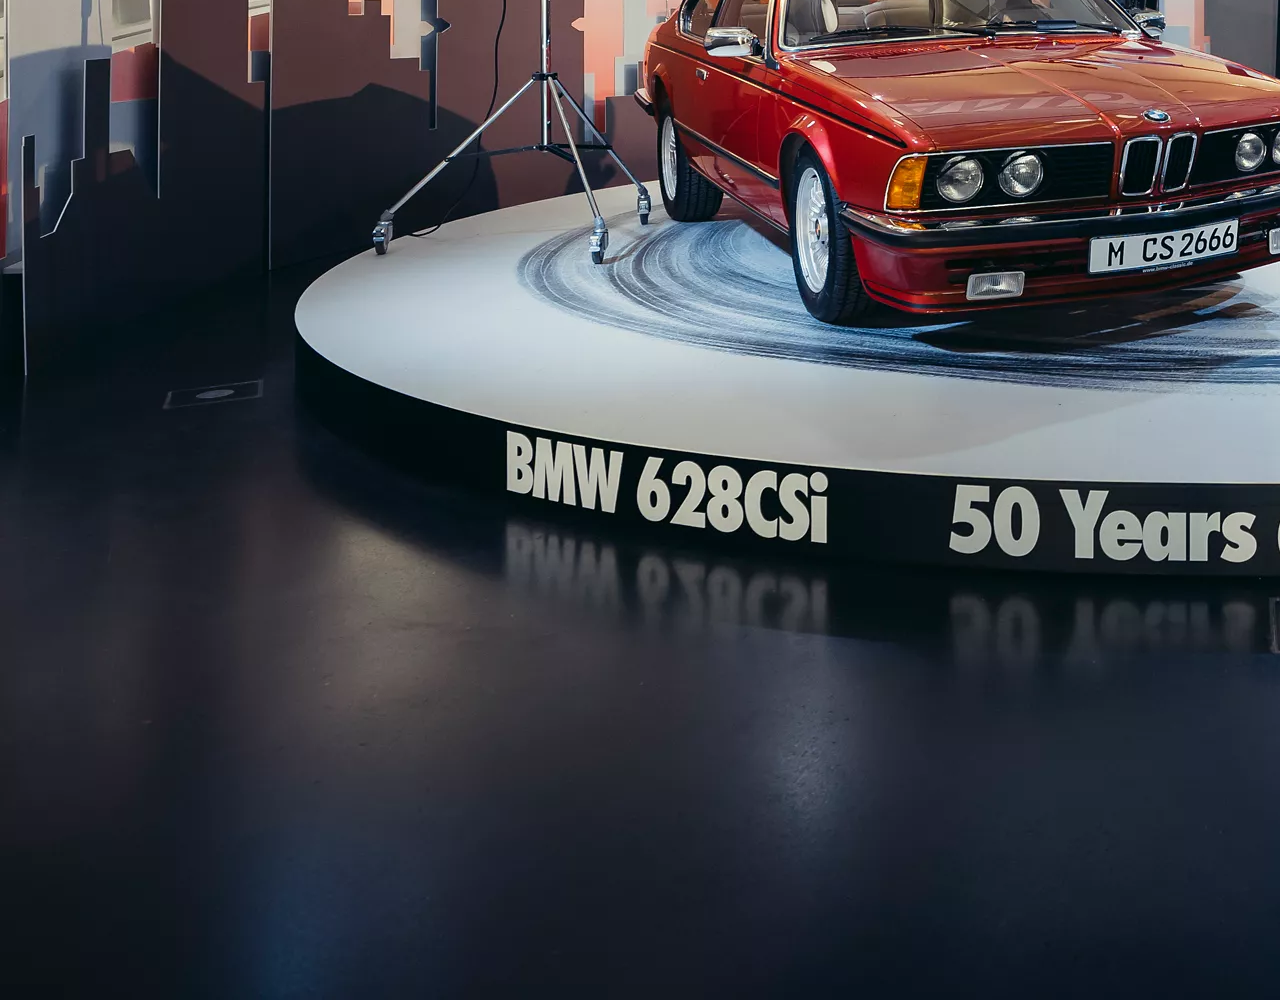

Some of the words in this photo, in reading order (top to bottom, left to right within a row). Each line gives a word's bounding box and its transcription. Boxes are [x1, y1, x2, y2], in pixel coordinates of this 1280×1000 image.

[1107, 240, 1125, 267] M
[1142, 235, 1174, 262] CS
[1179, 224, 1235, 257] 2666
[506, 430, 623, 514] BMW
[636, 456, 829, 544] 628CSi
[948, 484, 1040, 557] 50
[1060, 489, 1257, 563] Years
